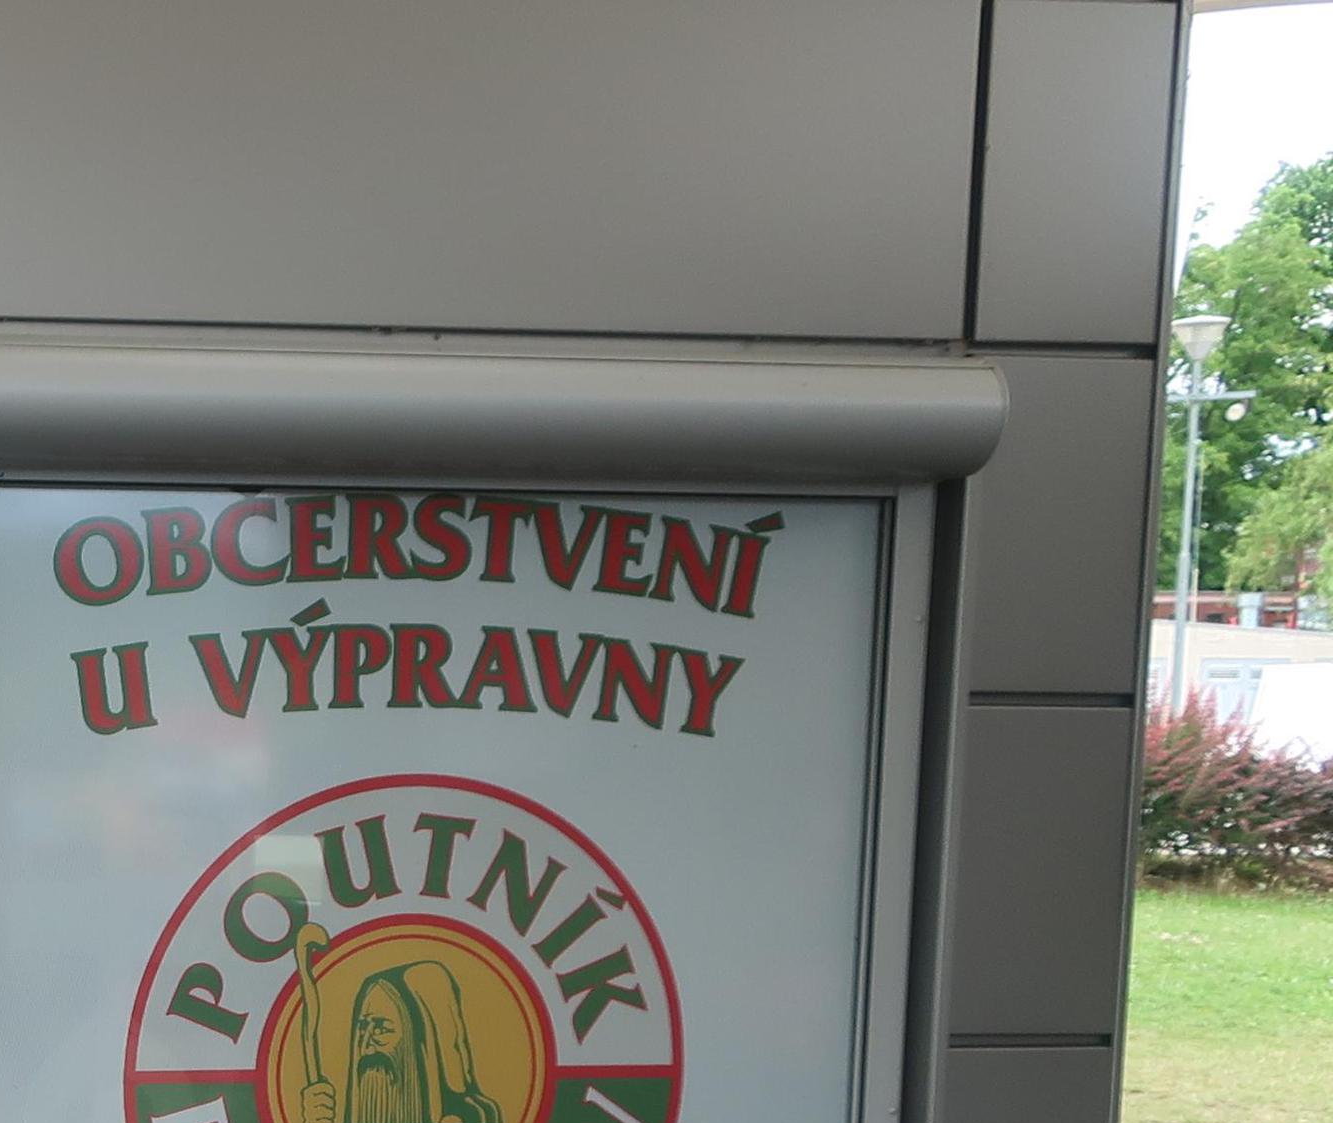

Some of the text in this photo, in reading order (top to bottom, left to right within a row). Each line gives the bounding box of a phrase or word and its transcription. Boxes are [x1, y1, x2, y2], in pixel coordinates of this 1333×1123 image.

[71, 599, 745, 738] U VÝPRAVNY
[165, 812, 649, 1044] POUTNÍK
